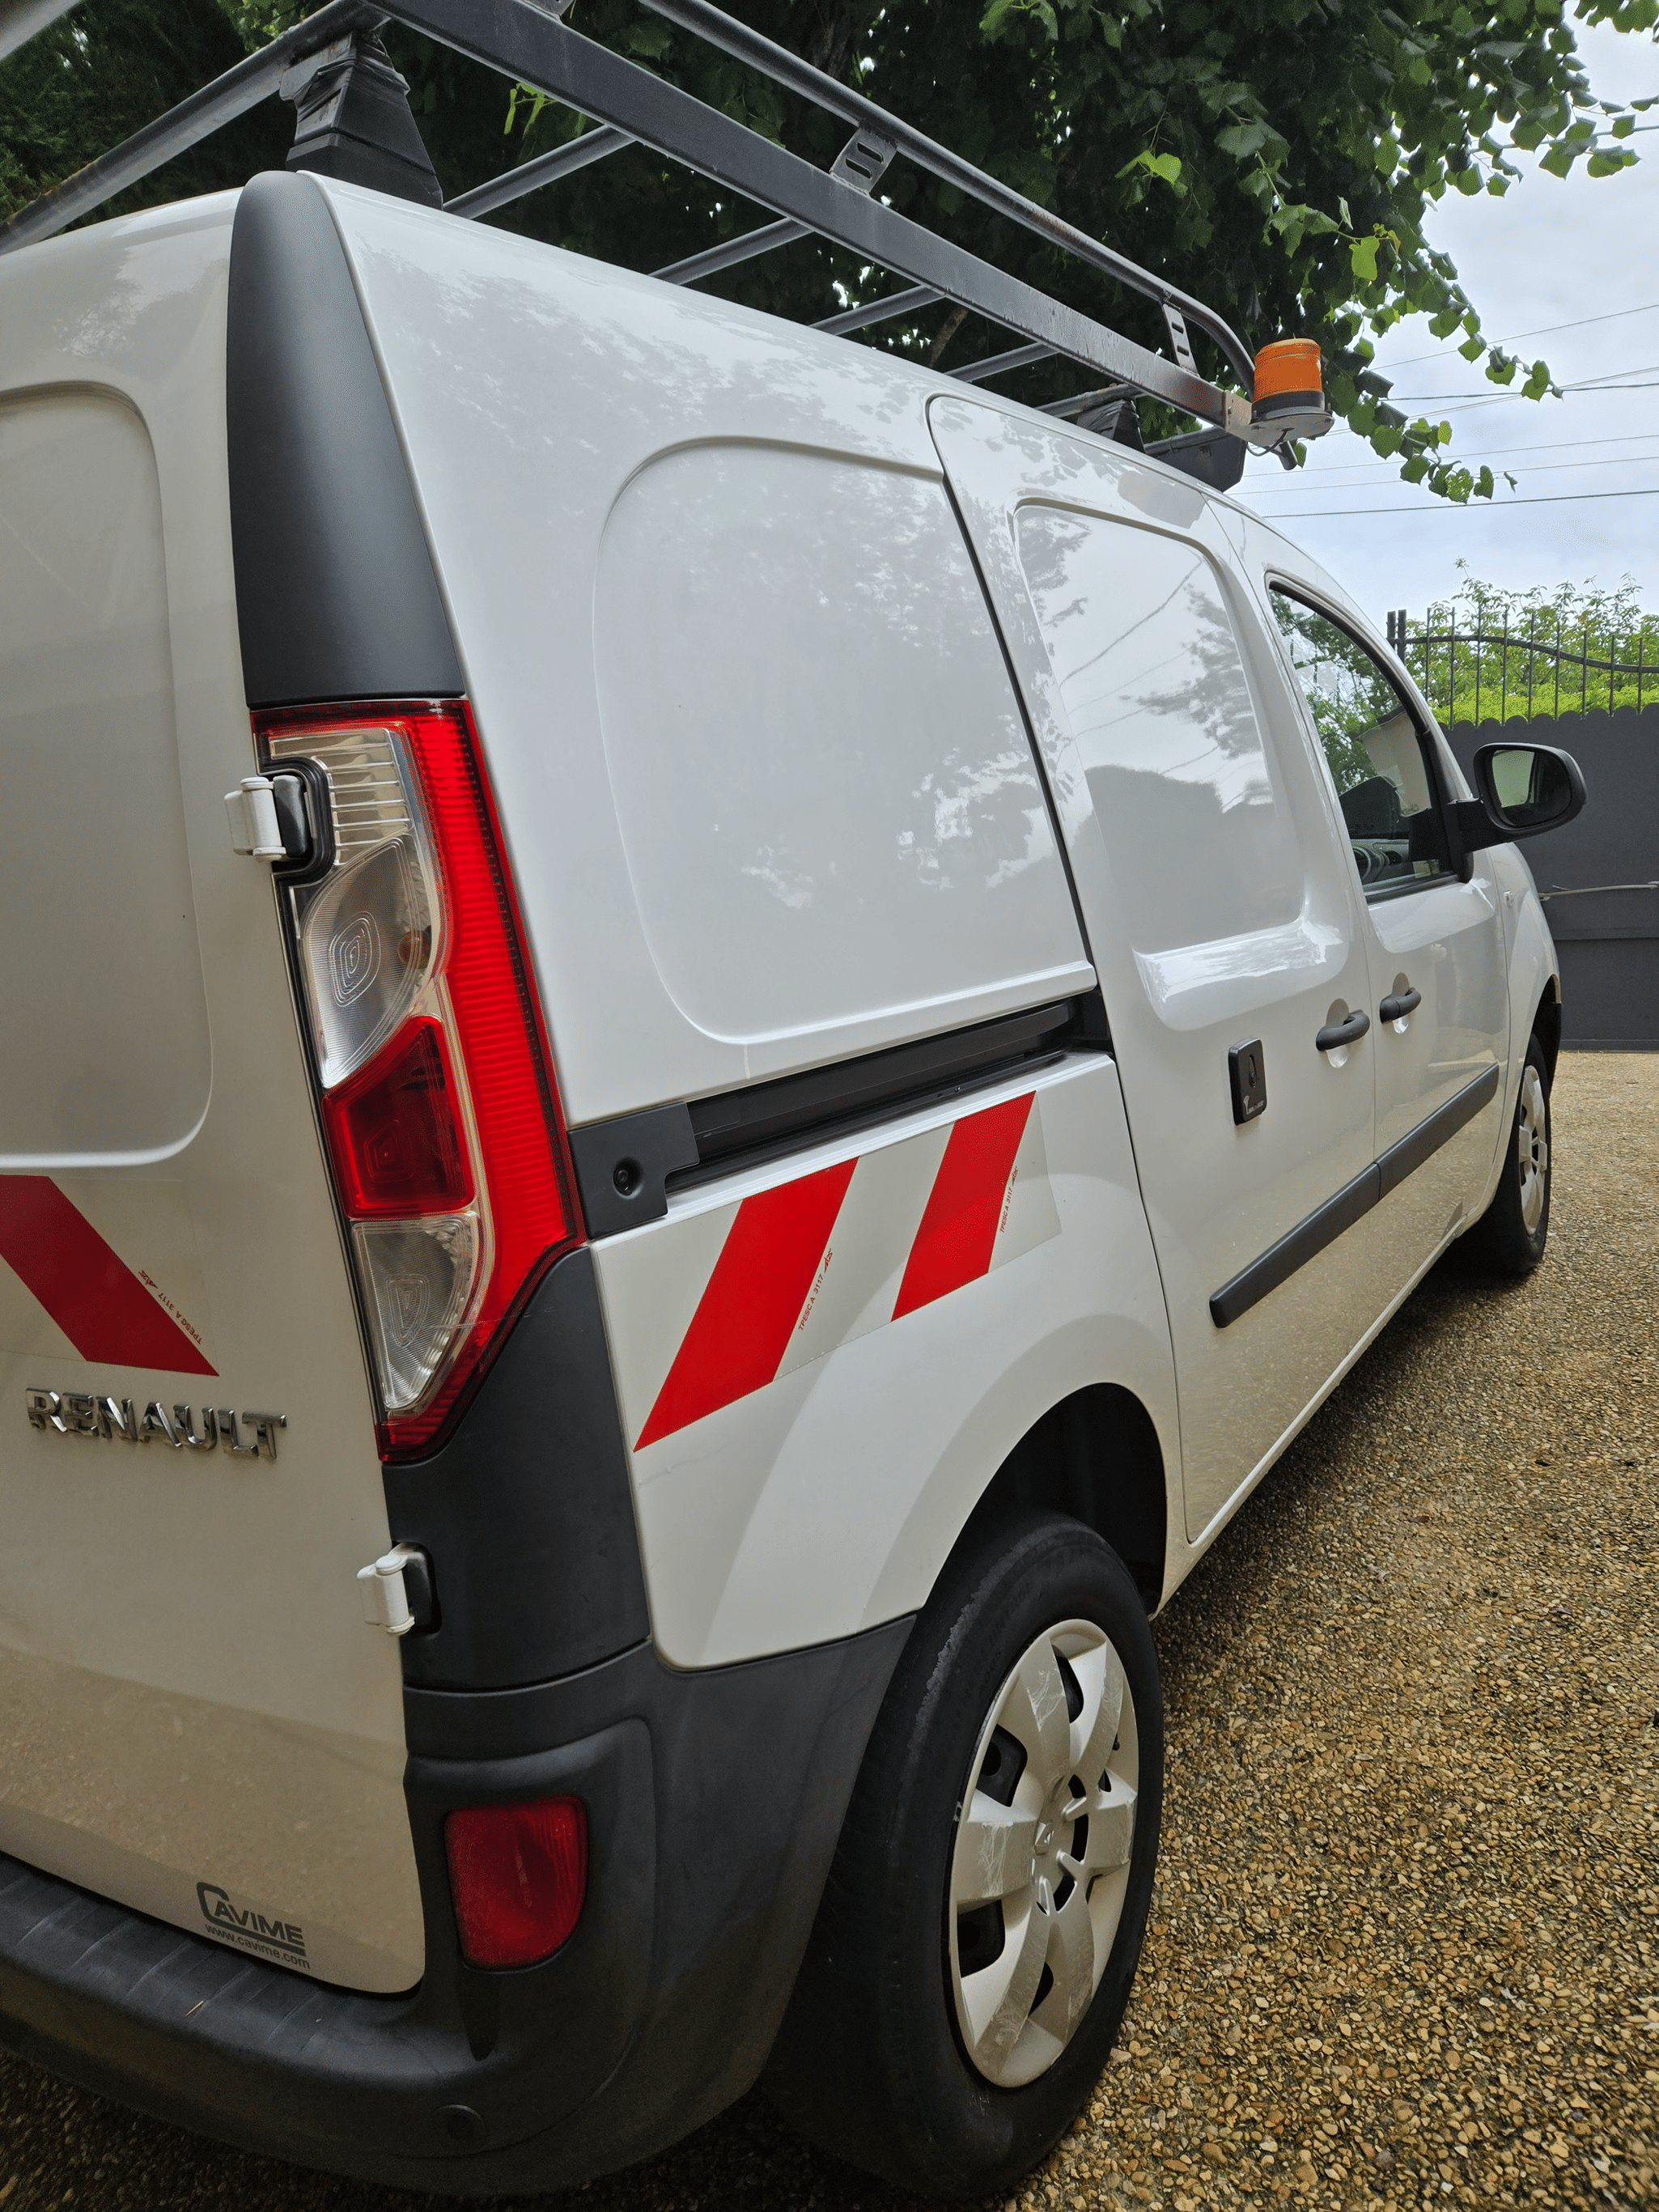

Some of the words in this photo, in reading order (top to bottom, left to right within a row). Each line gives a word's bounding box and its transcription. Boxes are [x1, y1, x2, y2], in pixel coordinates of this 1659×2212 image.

[158, 1293, 175, 1311] 3117
[813, 1273, 824, 1294] 3117
[25, 1386, 288, 1460] RENAULT
[196, 1882, 307, 1956] CAVIME
[205, 1924, 311, 1970] www.cavime.com
